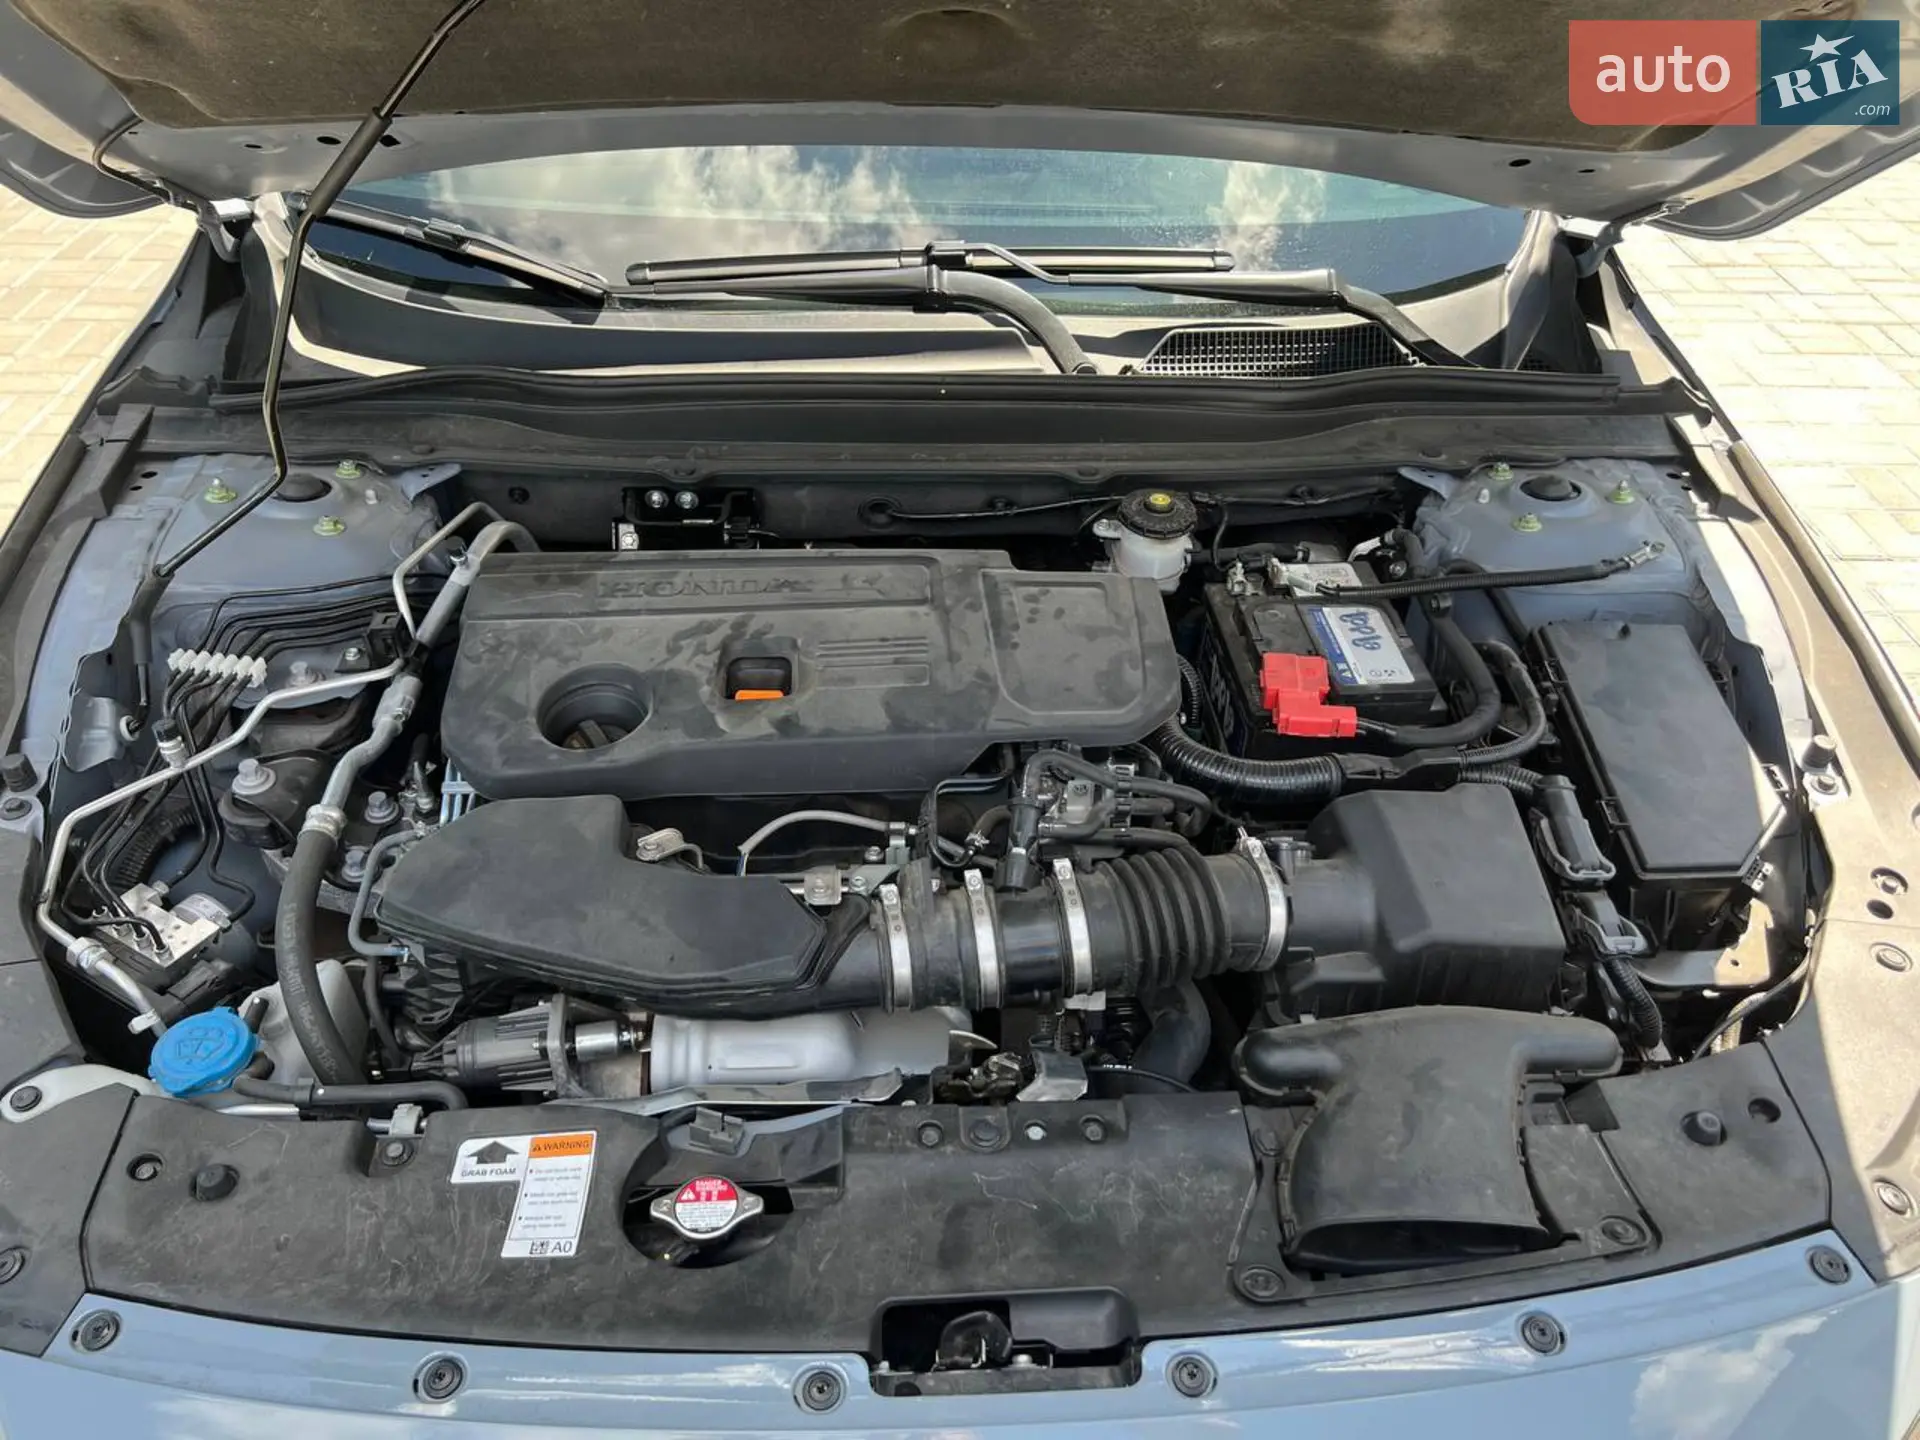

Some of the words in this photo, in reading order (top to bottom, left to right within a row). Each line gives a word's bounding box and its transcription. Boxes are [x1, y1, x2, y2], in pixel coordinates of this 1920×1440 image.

[543, 1139, 590, 1151] WARNING
[461, 1168, 488, 1177] GRAB
[488, 1167, 517, 1176] FOAM
